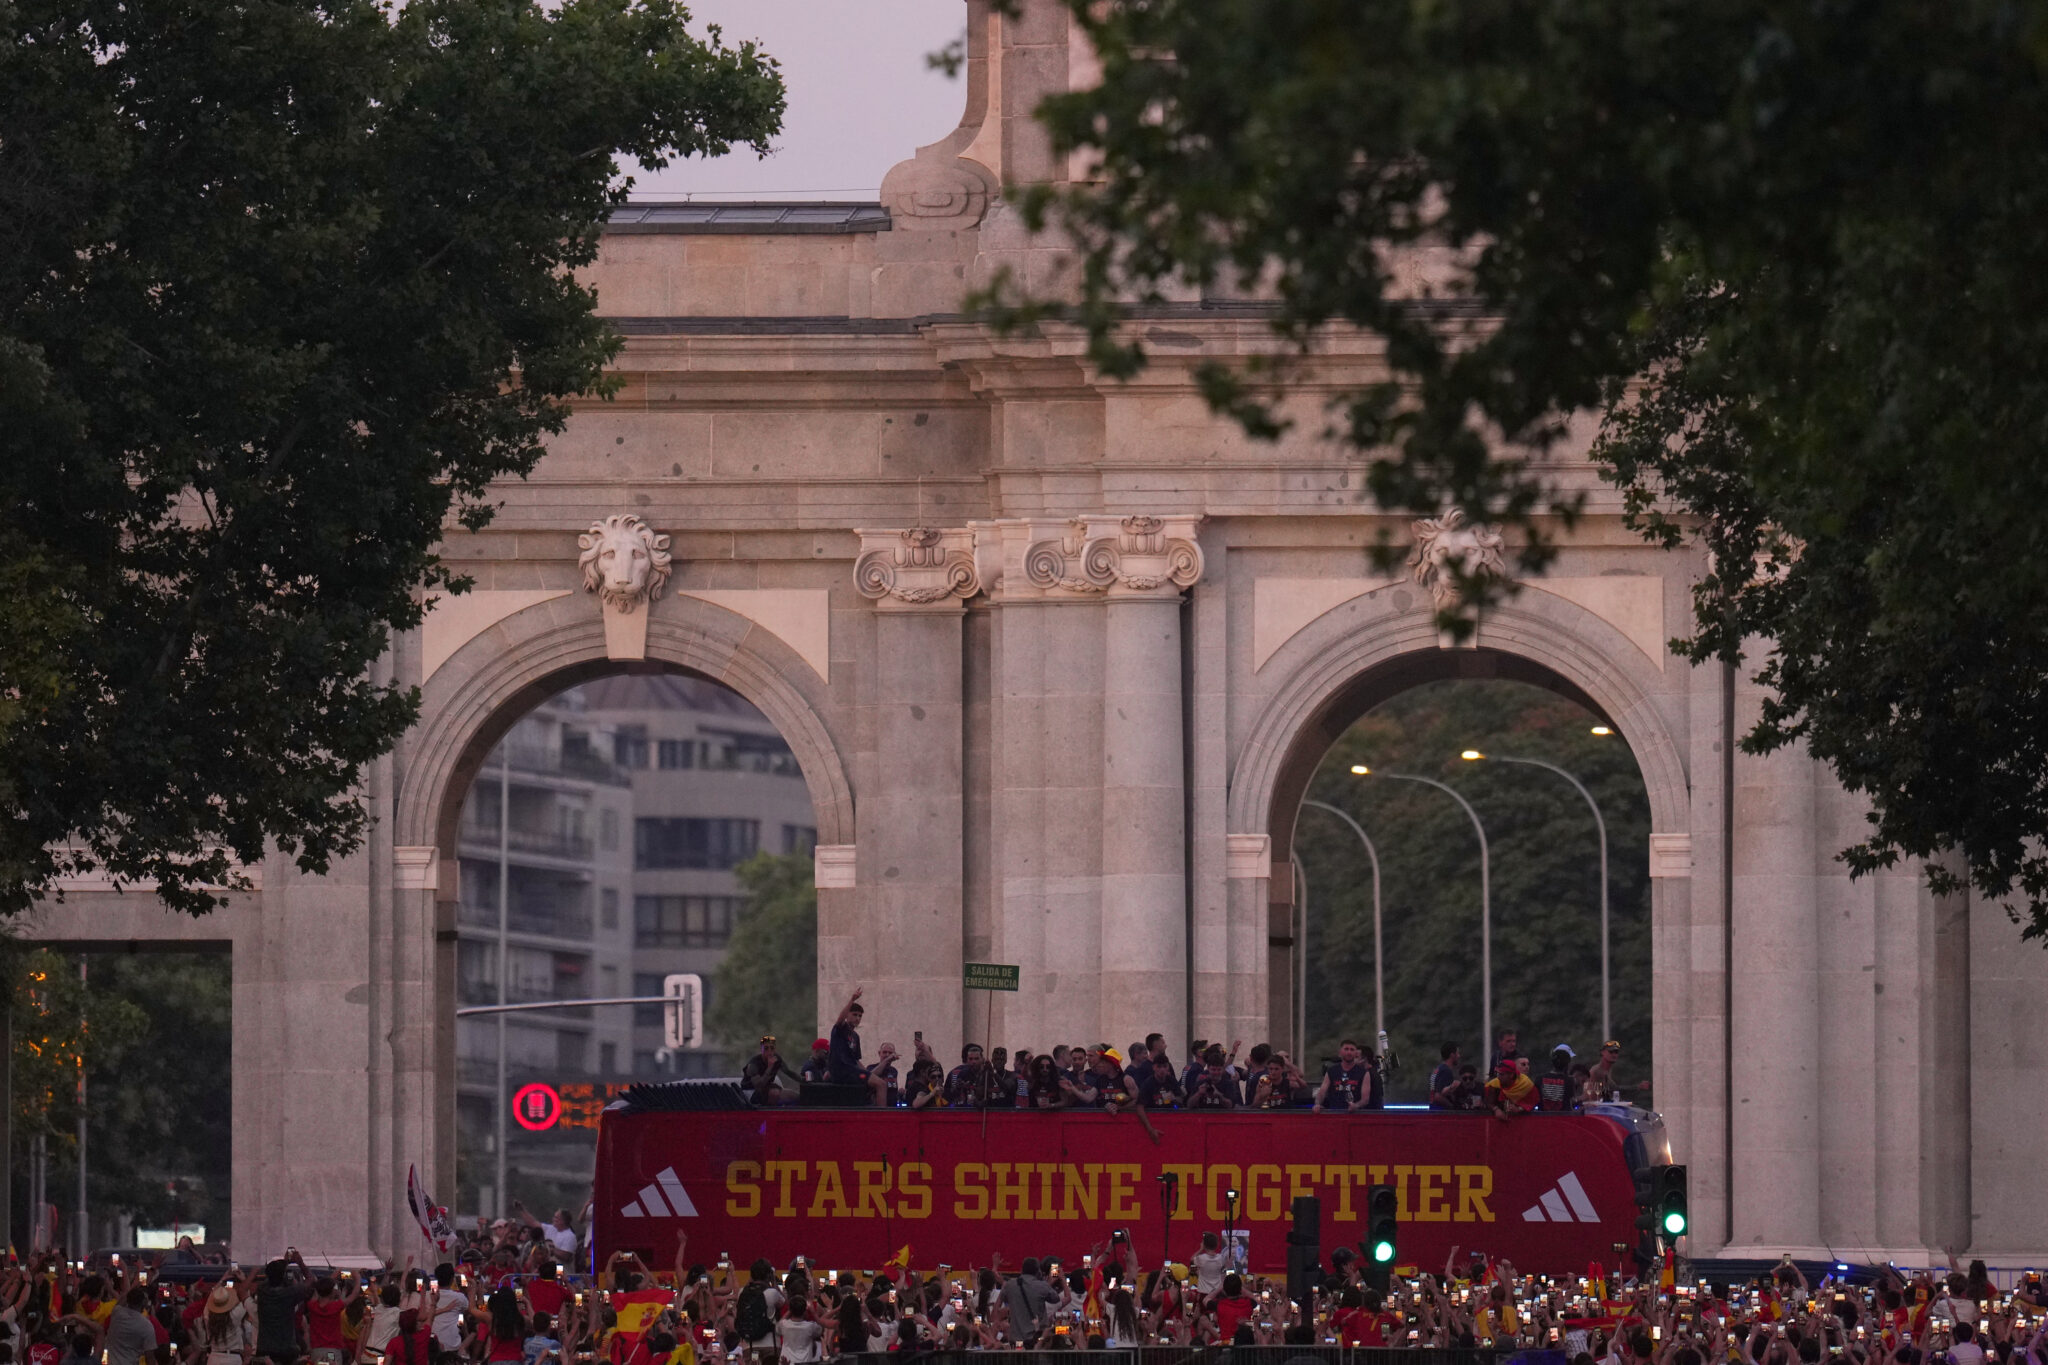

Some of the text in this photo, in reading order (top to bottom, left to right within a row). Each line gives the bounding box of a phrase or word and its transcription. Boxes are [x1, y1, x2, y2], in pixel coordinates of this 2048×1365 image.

[971, 966, 1013, 977] SALIDA DE
[965, 976, 1018, 989] EMERGENCIA
[726, 1160, 933, 1219] STARS
[954, 1162, 1142, 1220] SHINE
